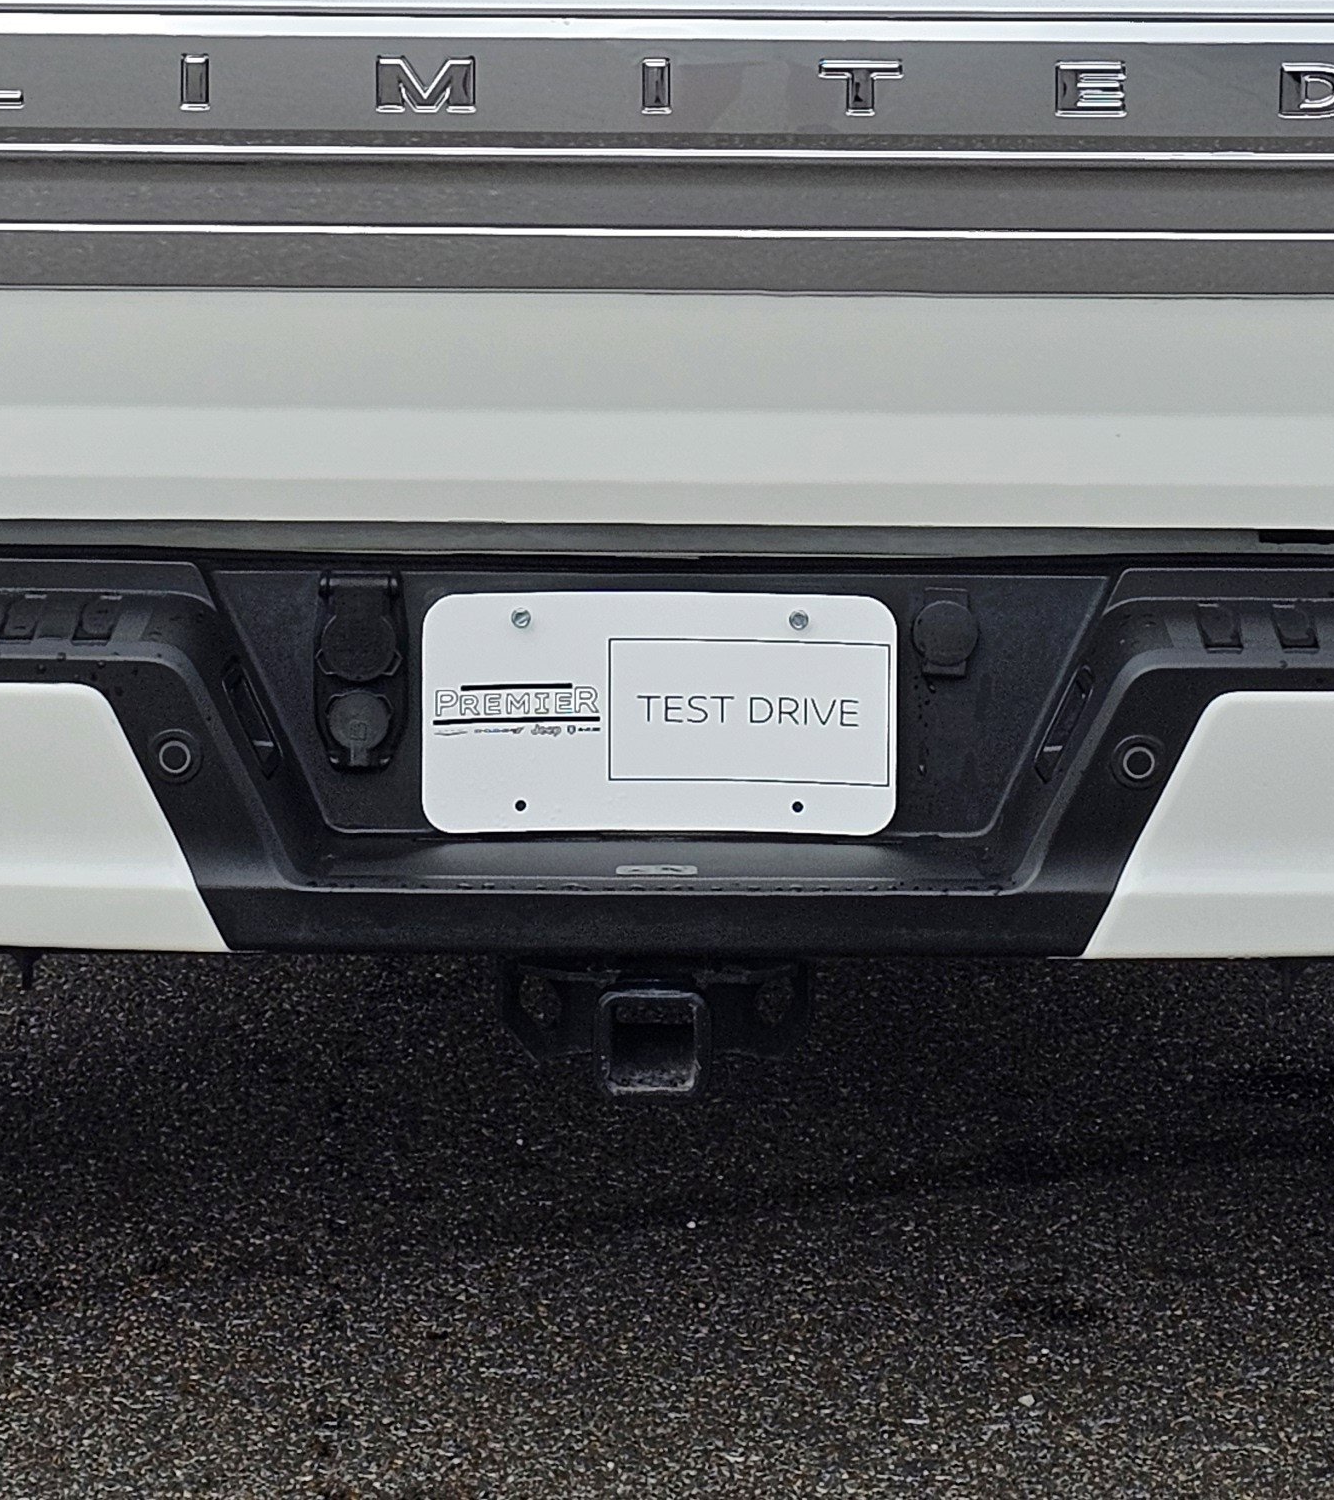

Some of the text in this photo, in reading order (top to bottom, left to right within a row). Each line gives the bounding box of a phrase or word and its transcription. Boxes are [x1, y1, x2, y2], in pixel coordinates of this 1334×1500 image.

[435, 686, 859, 727] PREMIER TEST DRIVE
[530, 724, 562, 738] Jeep
